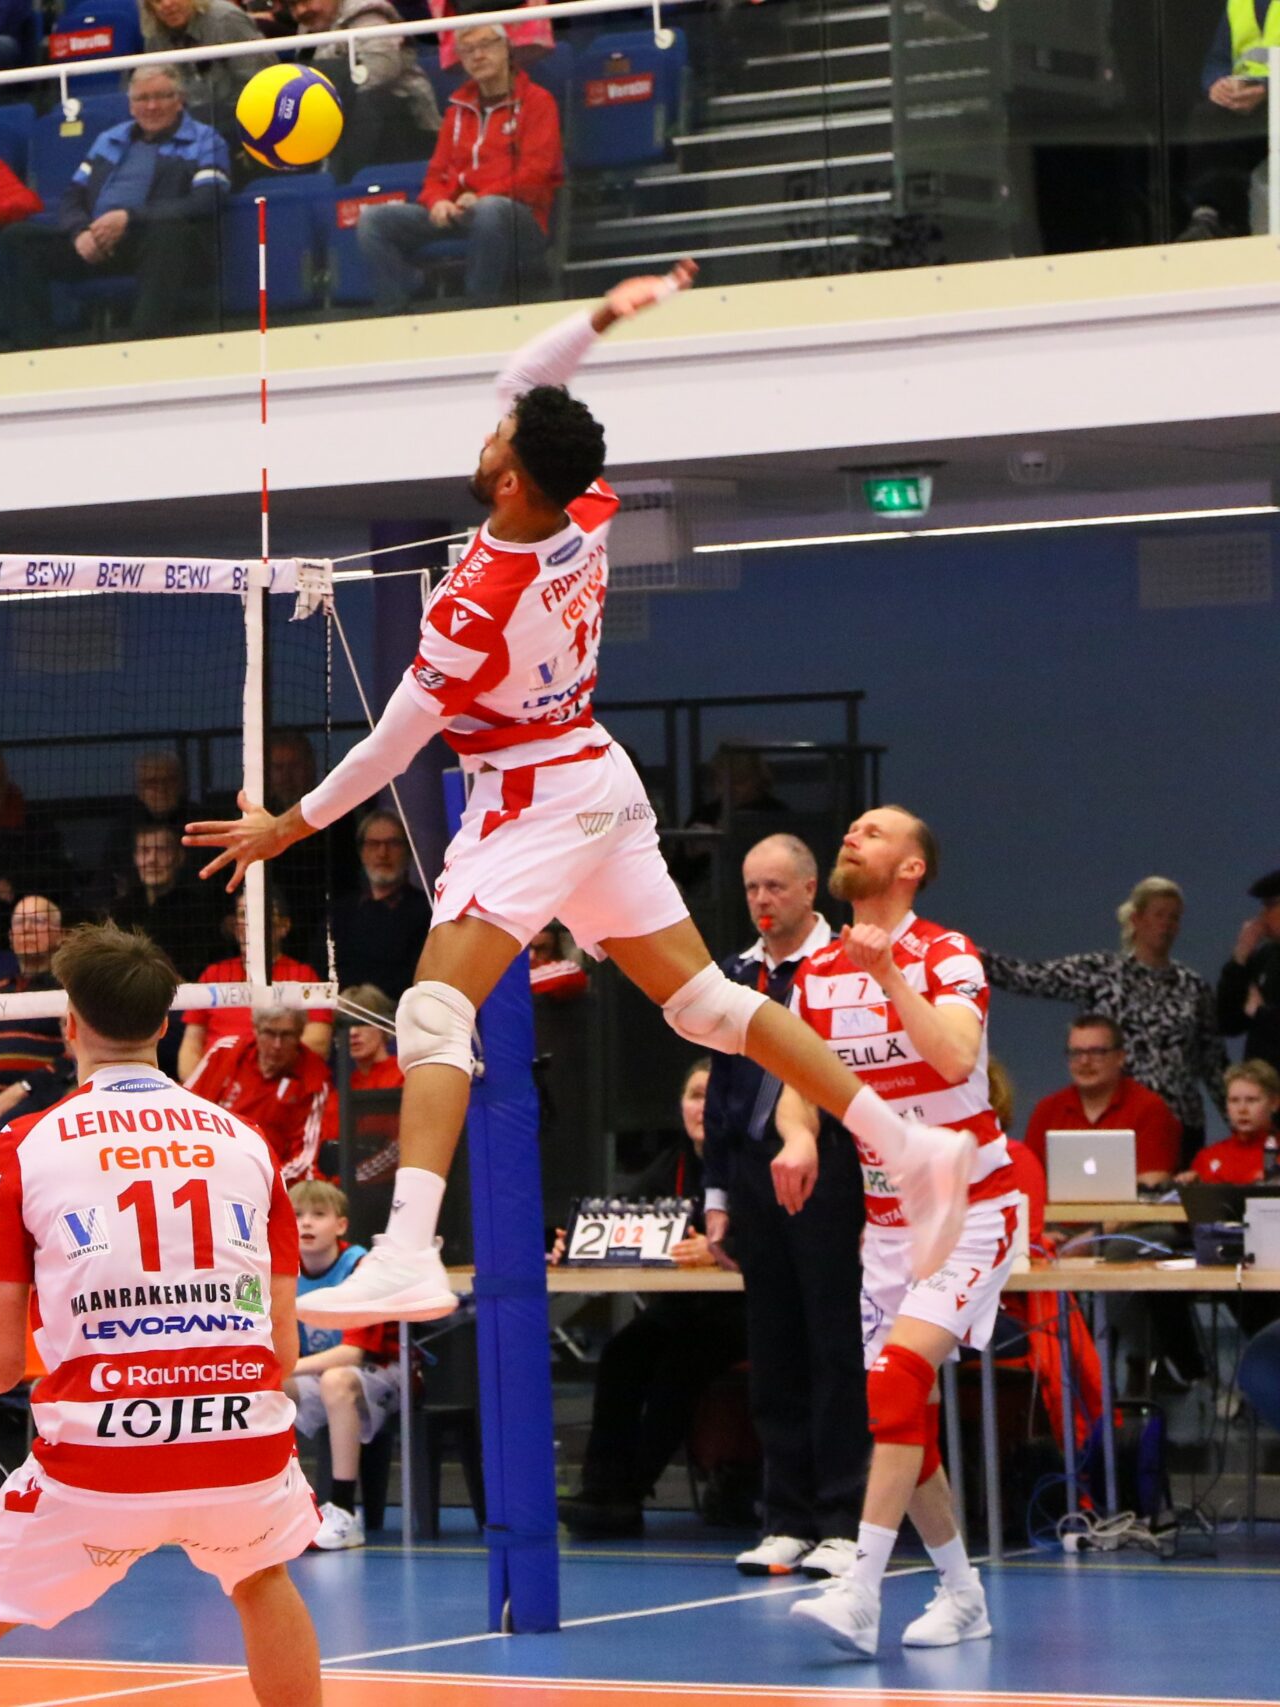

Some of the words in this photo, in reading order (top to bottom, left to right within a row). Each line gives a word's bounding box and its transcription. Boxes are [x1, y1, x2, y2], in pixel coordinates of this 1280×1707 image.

[25, 562, 75, 586] BEWI
[96, 563, 145, 588] BEWI
[165, 564, 211, 588] BEWI
[858, 978, 868, 1000] 7
[833, 1038, 908, 1067] ELILÄ
[58, 1107, 236, 1142] LEINONEN
[99, 1140, 215, 1172] renta
[117, 1179, 214, 1272] 11
[575, 1222, 606, 1255] 2
[658, 1221, 674, 1254] 1
[966, 1266, 981, 1288] 7
[127, 1359, 265, 1386] Raumaster
[97, 1396, 251, 1443] LOJER
